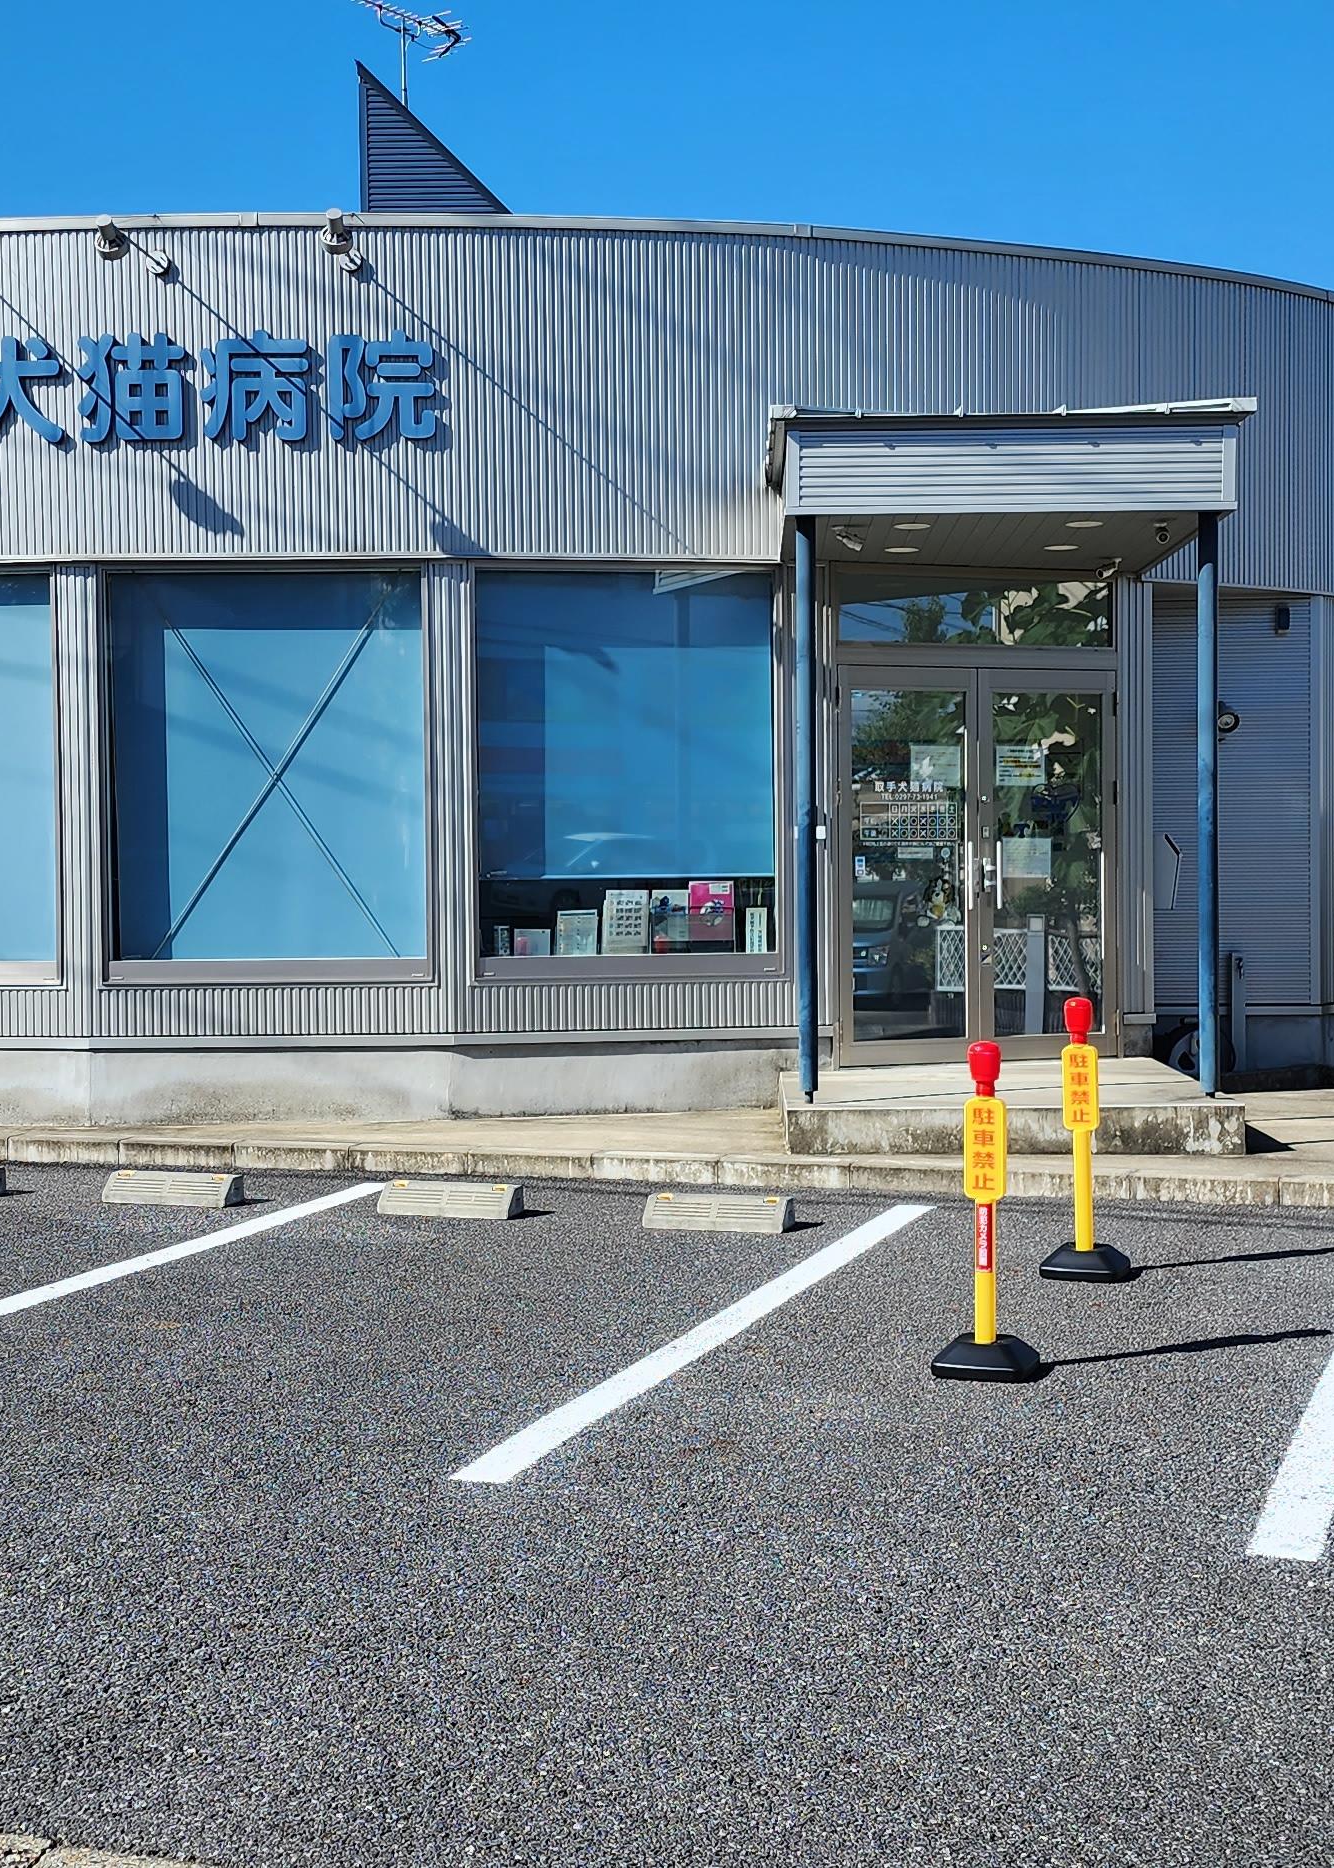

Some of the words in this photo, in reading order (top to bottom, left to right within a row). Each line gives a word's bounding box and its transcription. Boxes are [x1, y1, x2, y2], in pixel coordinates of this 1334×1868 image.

[1070, 1054, 1091, 1123] 駐車禁止
[972, 1107, 995, 1191] 駐車禁止
